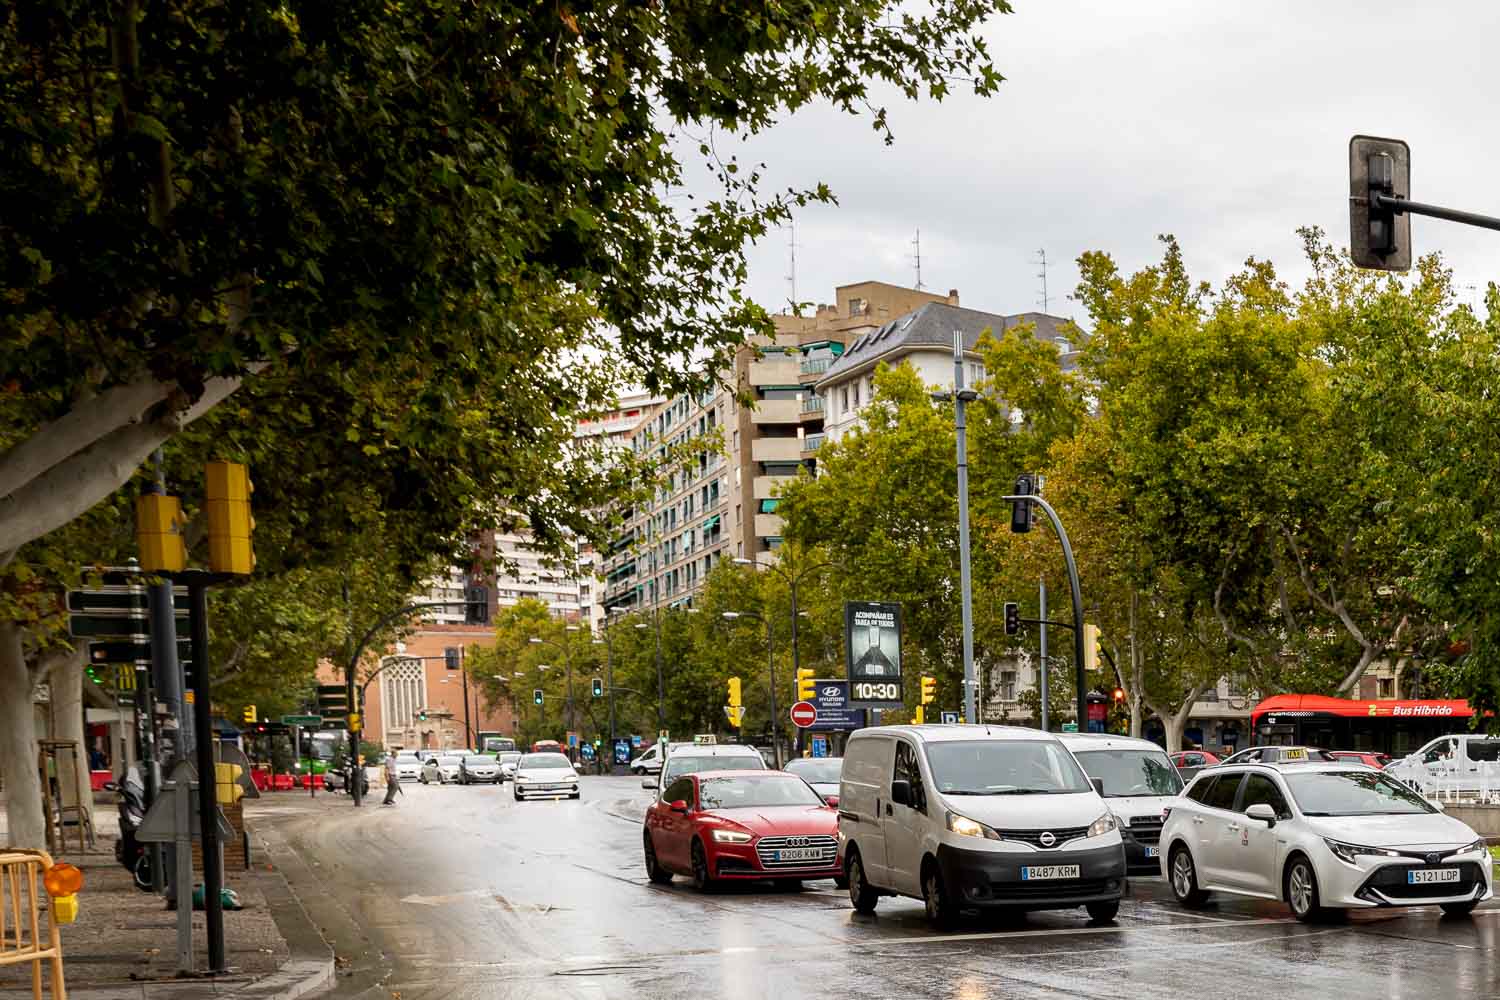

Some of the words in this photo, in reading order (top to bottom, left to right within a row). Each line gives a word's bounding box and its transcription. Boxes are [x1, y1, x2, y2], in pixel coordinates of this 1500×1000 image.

[855, 683, 897, 699] 10:30
[1393, 704, 1412, 716] Bus
[1413, 705, 1453, 716] Híbrido
[1029, 867, 1055, 878] 8487
[1057, 866, 1078, 877] KRM
[1415, 871, 1439, 882] 5121
[1441, 870, 1458, 881] LDP
